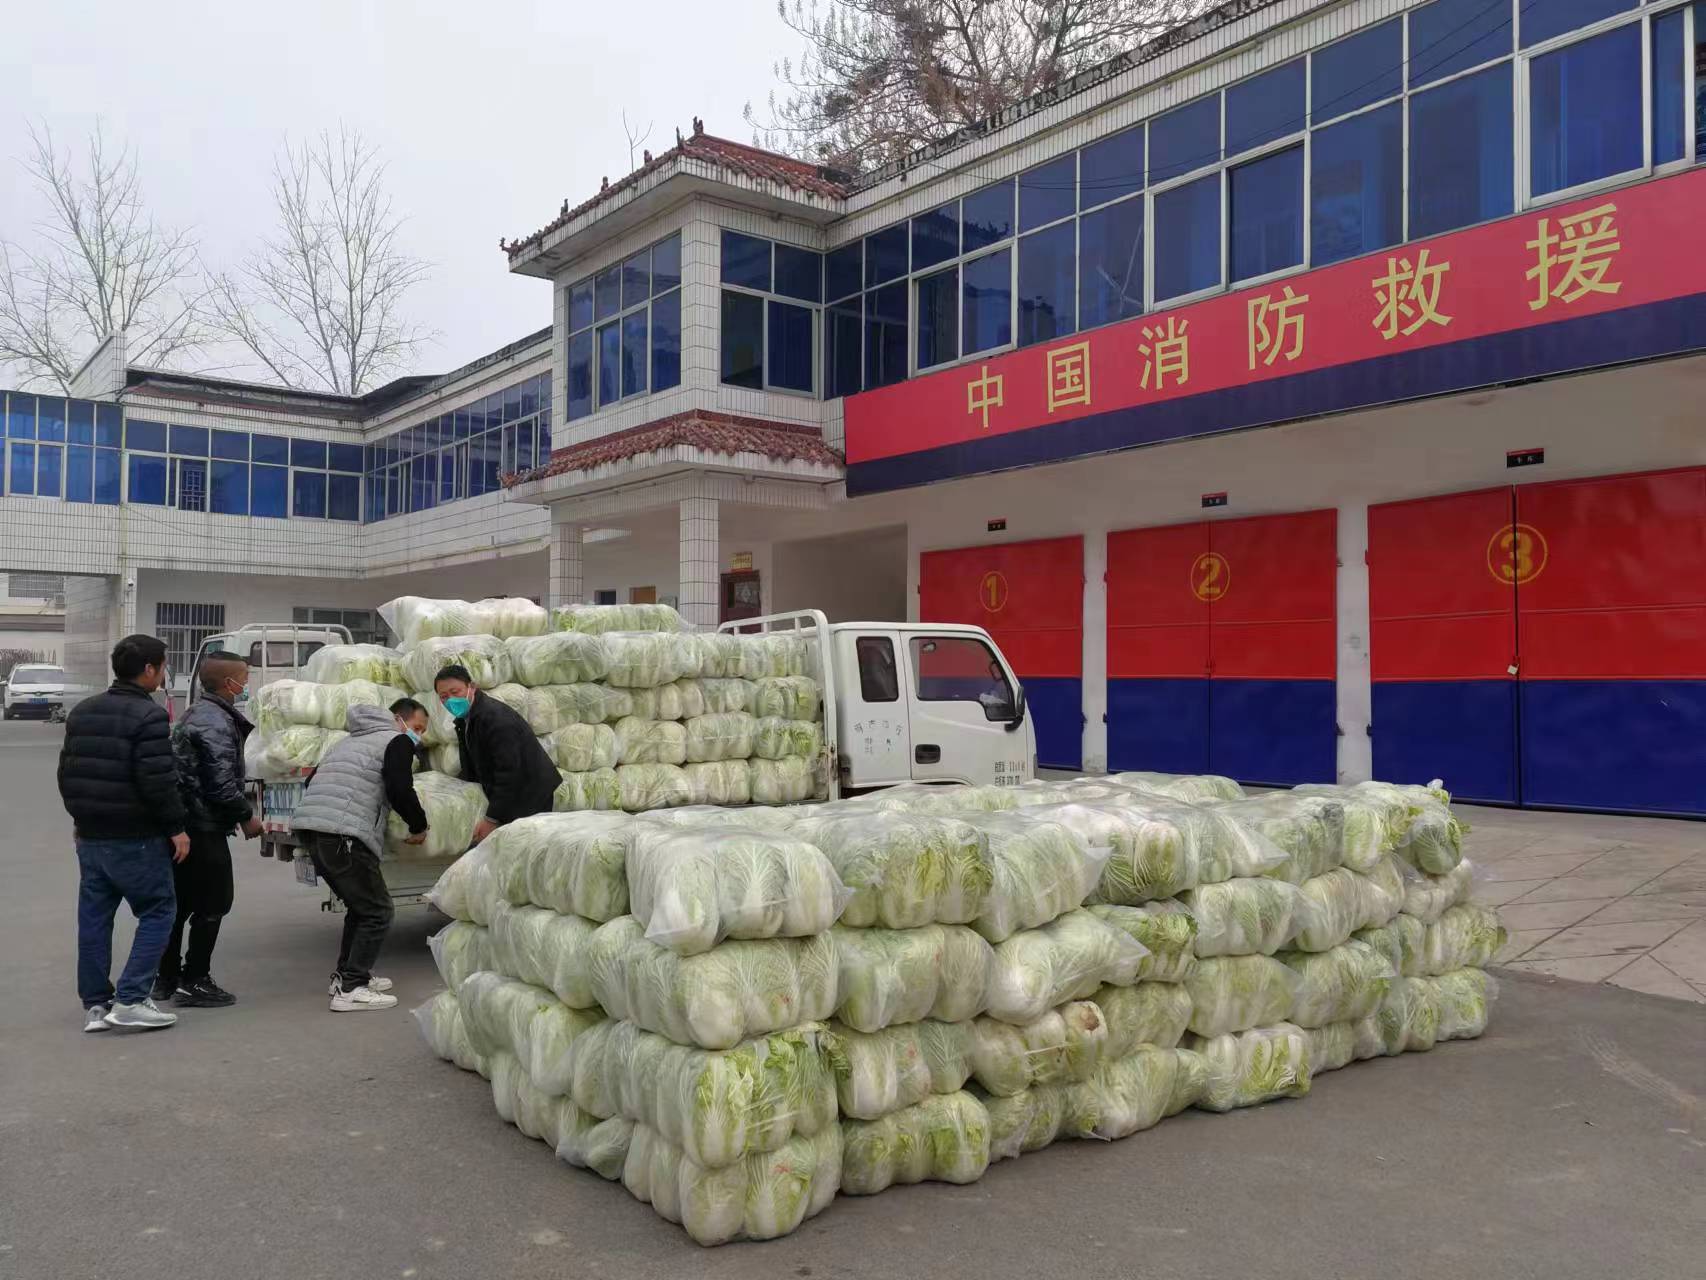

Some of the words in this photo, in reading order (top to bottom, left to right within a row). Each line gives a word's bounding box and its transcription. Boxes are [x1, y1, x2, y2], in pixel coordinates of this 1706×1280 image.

[967, 203, 1622, 428] 中国消防救援
[1199, 557, 1220, 595] 2
[1501, 532, 1533, 578] 3
